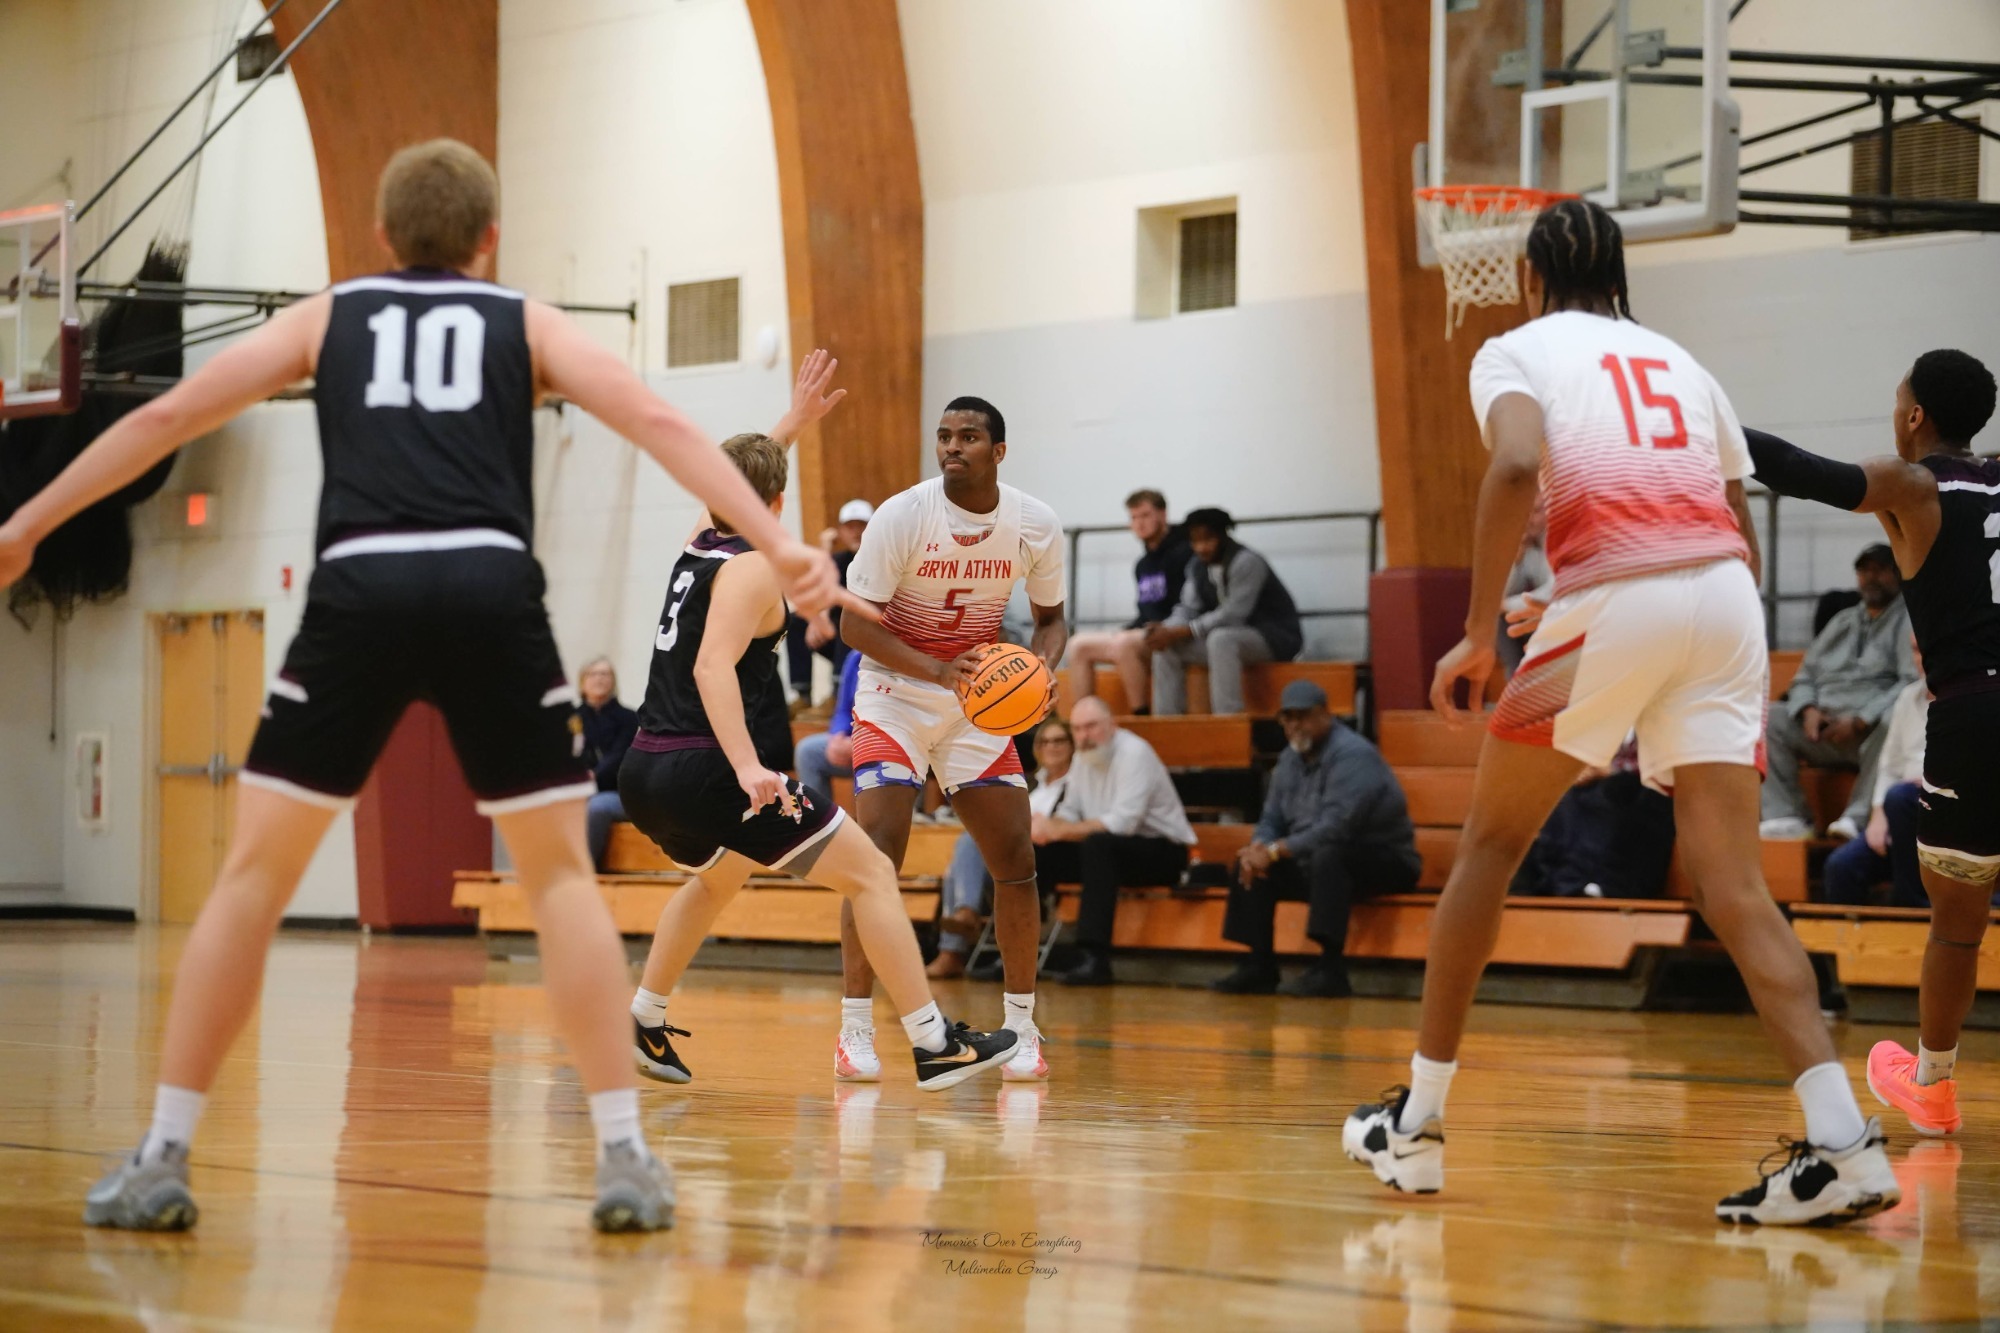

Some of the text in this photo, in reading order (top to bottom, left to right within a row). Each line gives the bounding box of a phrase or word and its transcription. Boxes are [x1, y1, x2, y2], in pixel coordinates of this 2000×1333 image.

[364, 303, 487, 413] 10
[1600, 353, 1689, 449] 15
[916, 559, 1012, 579] BRYN ATHYN
[655, 570, 696, 652] 3
[936, 587, 975, 632] 5
[973, 657, 1030, 699] Wilson
